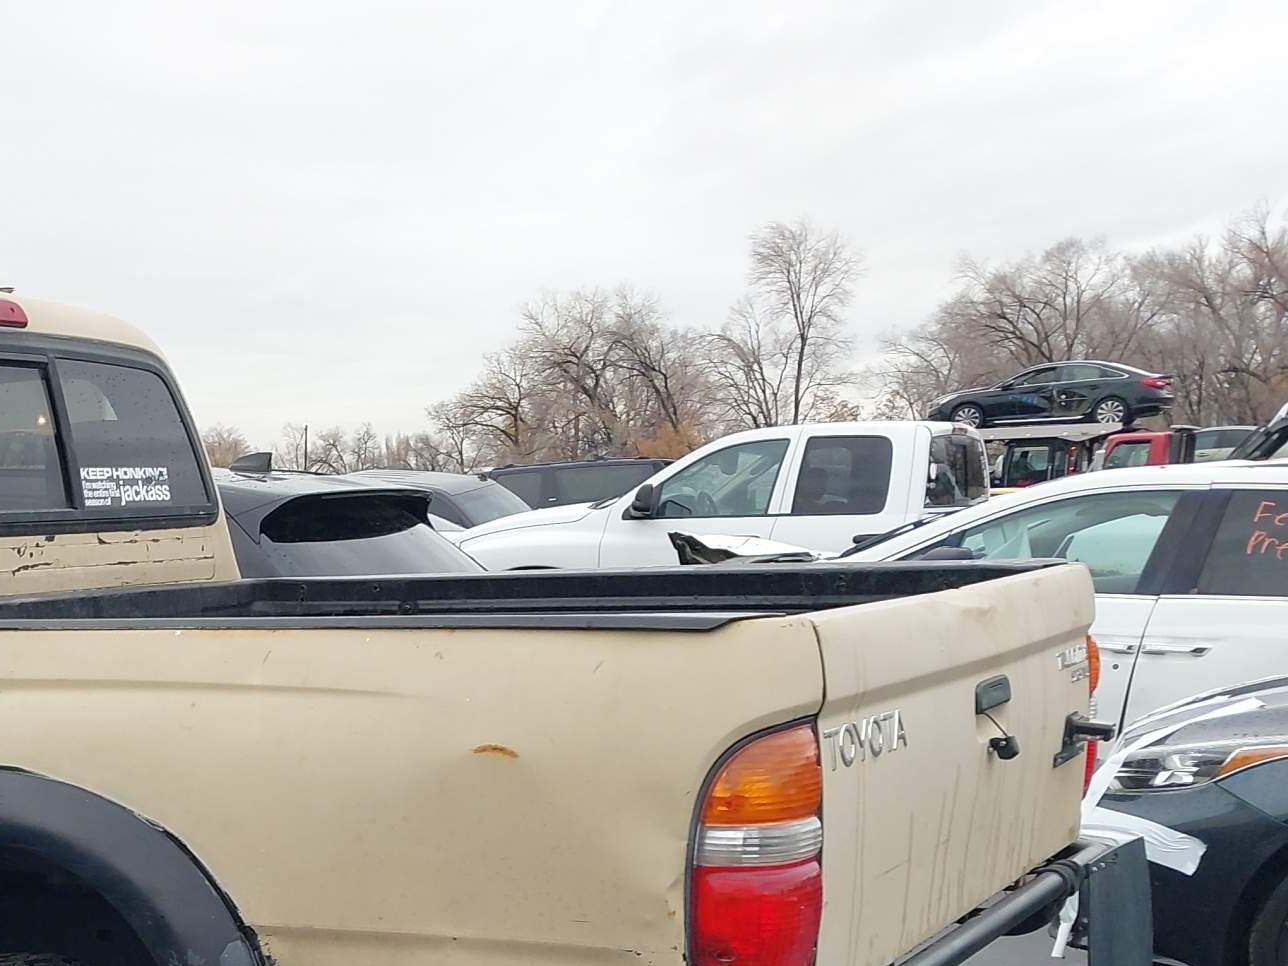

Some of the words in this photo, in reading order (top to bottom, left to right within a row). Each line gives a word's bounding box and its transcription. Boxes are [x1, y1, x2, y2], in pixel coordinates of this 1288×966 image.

[80, 467, 112, 479] KEEP
[119, 480, 171, 506] jackass
[824, 709, 908, 772] TOYOTA
